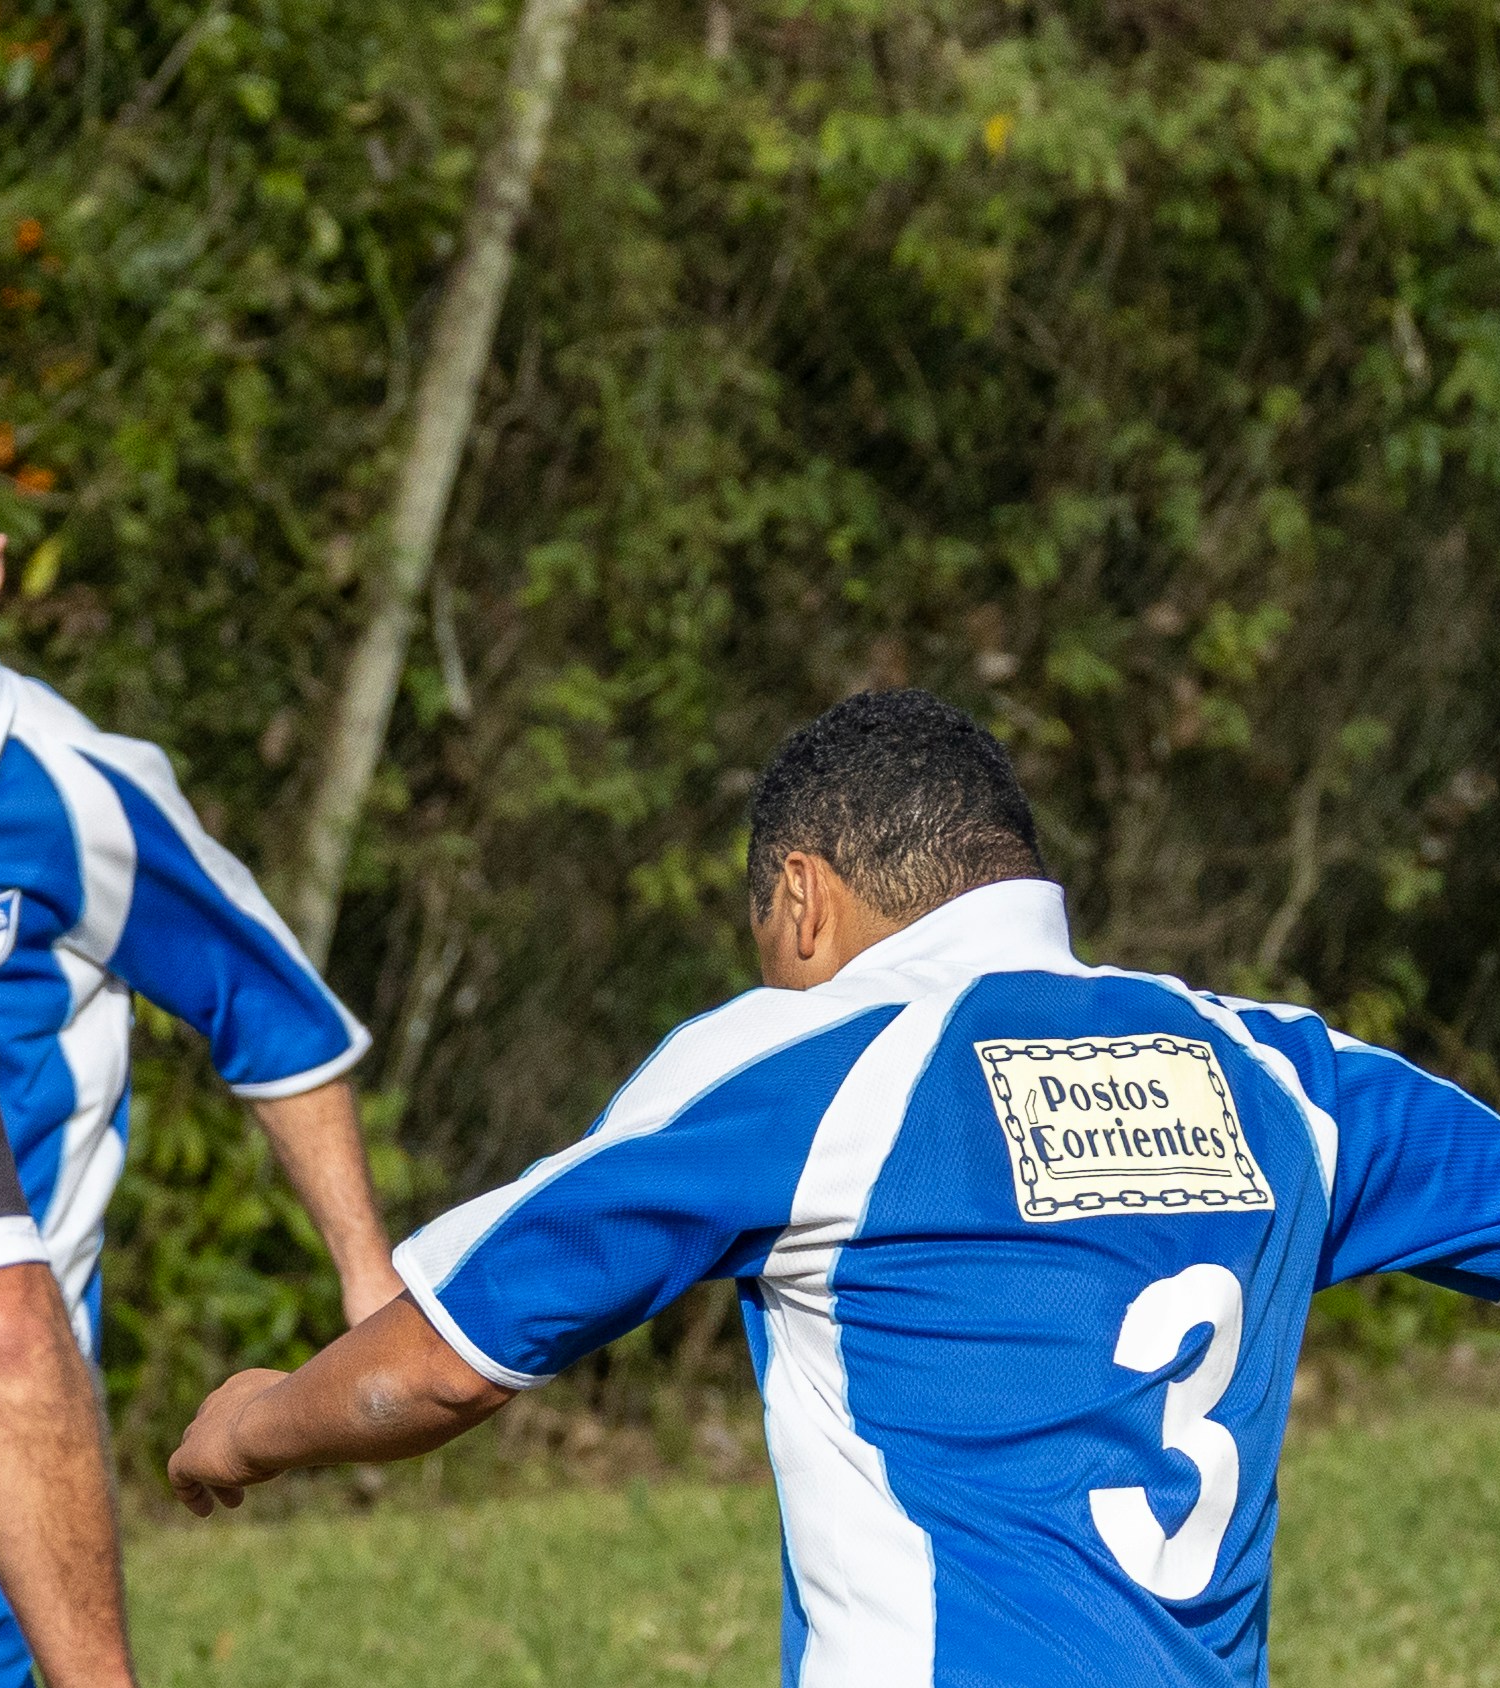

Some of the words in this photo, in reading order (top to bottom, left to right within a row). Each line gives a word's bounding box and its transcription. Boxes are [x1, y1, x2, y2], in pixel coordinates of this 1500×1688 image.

[1038, 1075, 1170, 1112] Postos
[1029, 1117, 1226, 1163] Corrientes
[1088, 1262, 1245, 1601] 3
